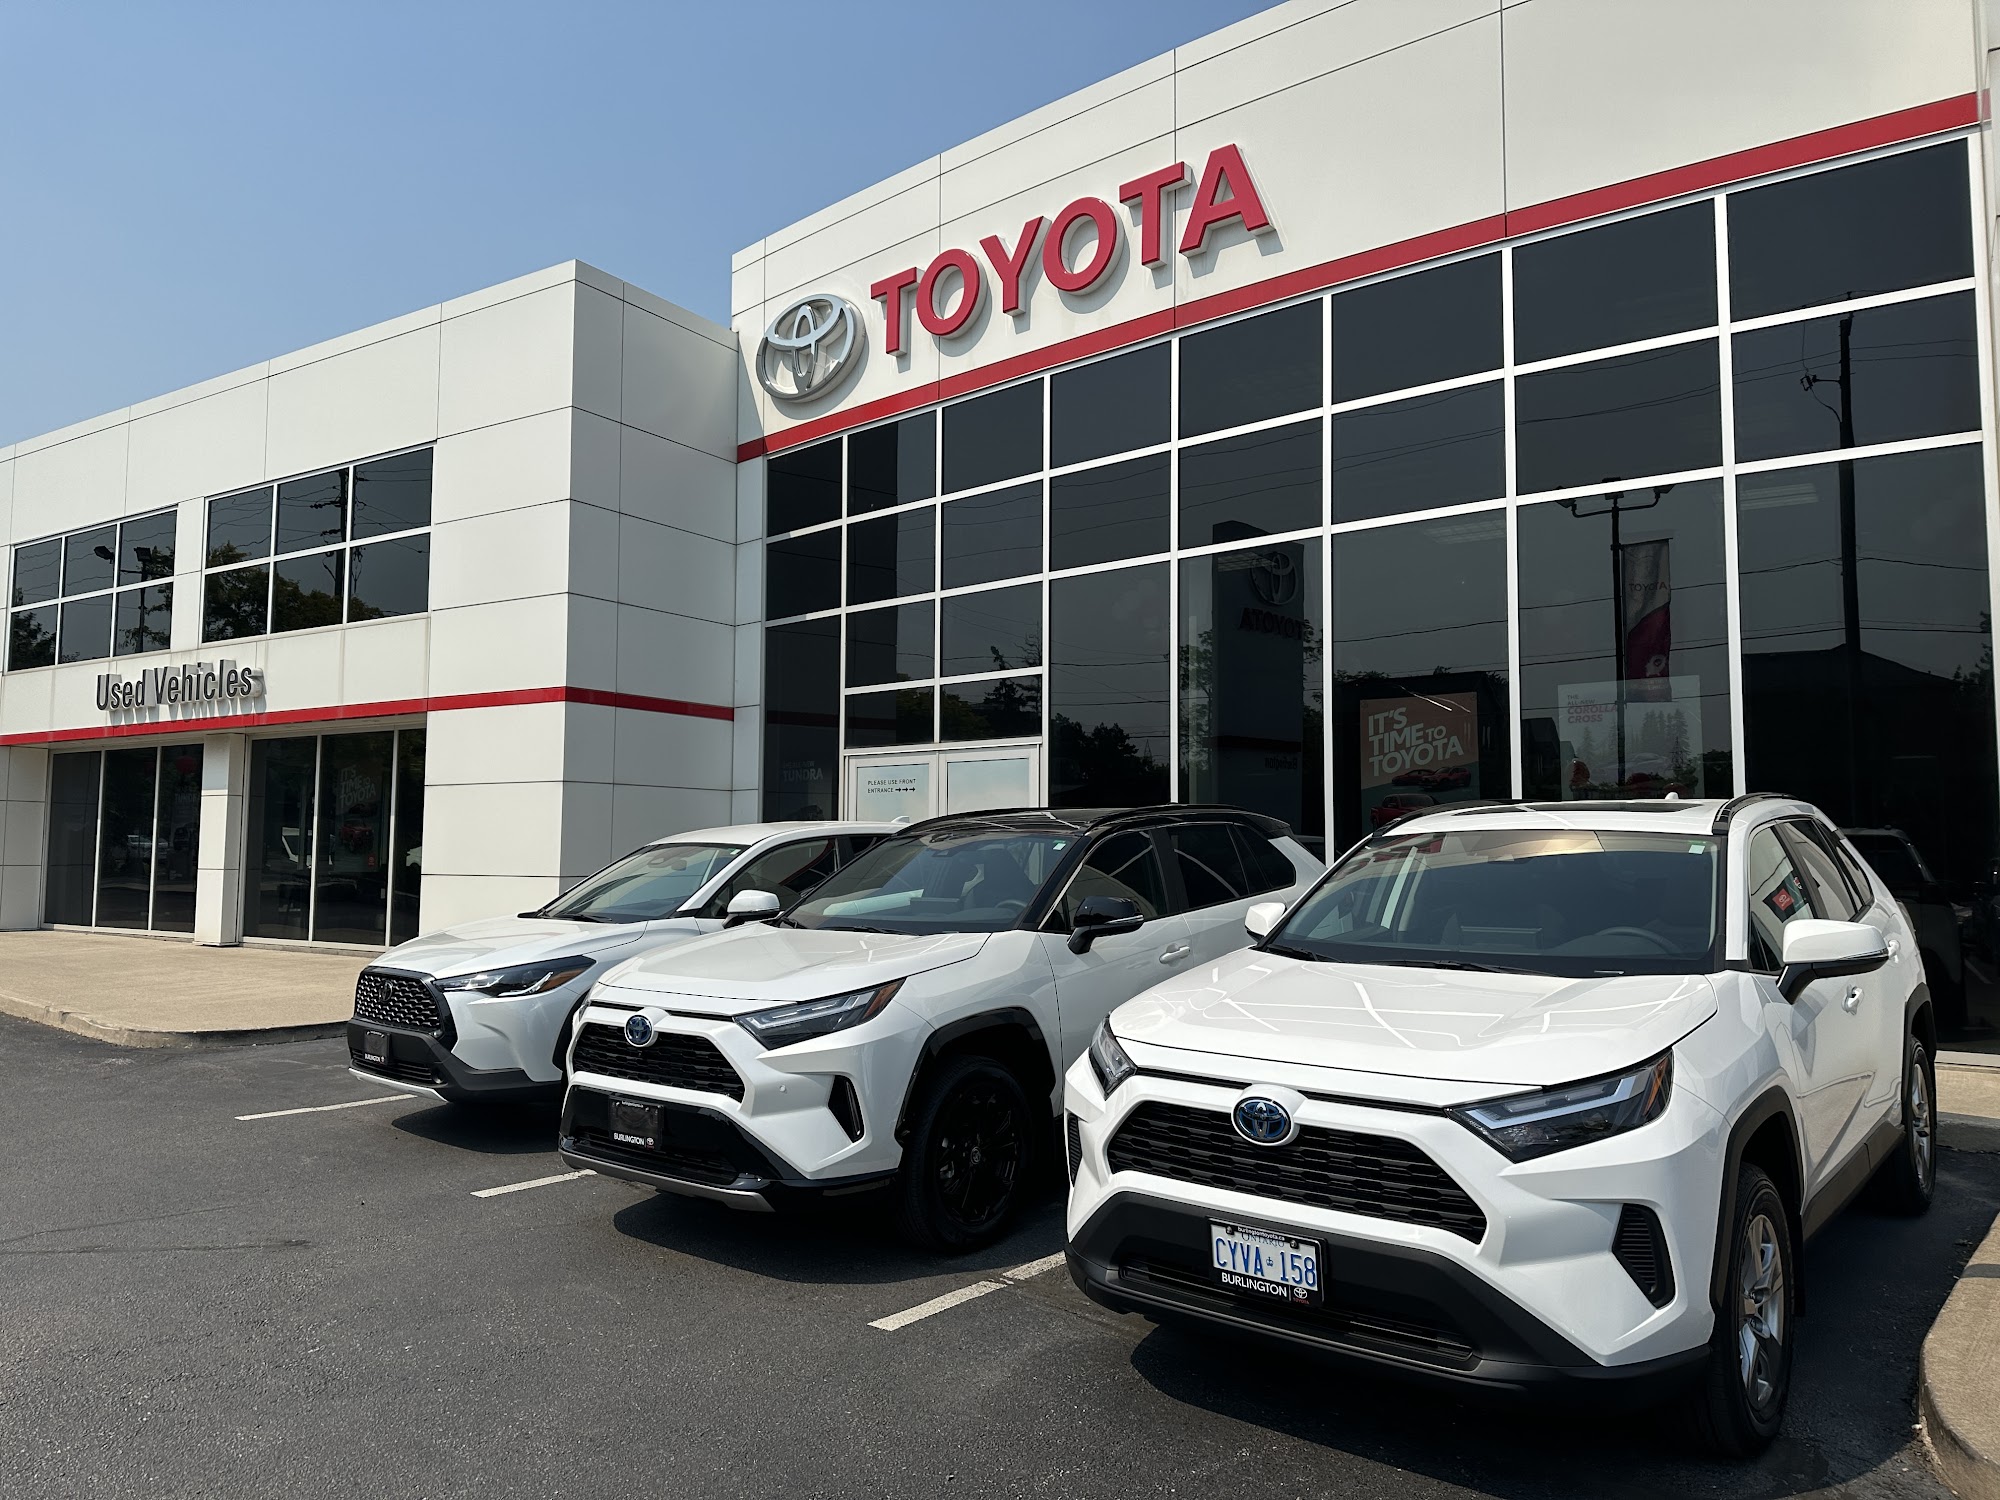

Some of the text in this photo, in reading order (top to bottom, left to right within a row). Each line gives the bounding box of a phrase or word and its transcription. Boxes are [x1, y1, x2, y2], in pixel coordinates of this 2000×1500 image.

[871, 143, 1273, 355] TOYOTA
[1629, 581, 1667, 592] TOYOTA
[97, 659, 255, 711] Used Vehicles
[1368, 707, 1408, 736] IT'S
[1567, 704, 1617, 715] COROLLA
[1568, 714, 1603, 724] CROSS
[1369, 723, 1447, 756] TIME TO
[1369, 735, 1464, 777] TOYOTA
[783, 767, 823, 782] TUNDRA
[339, 783, 377, 808] TOYOTA
[613, 1132, 645, 1146] BURLINGTON
[1215, 1238, 1317, 1288] CYVA 158
[1221, 1272, 1288, 1298] BURLINGTON
